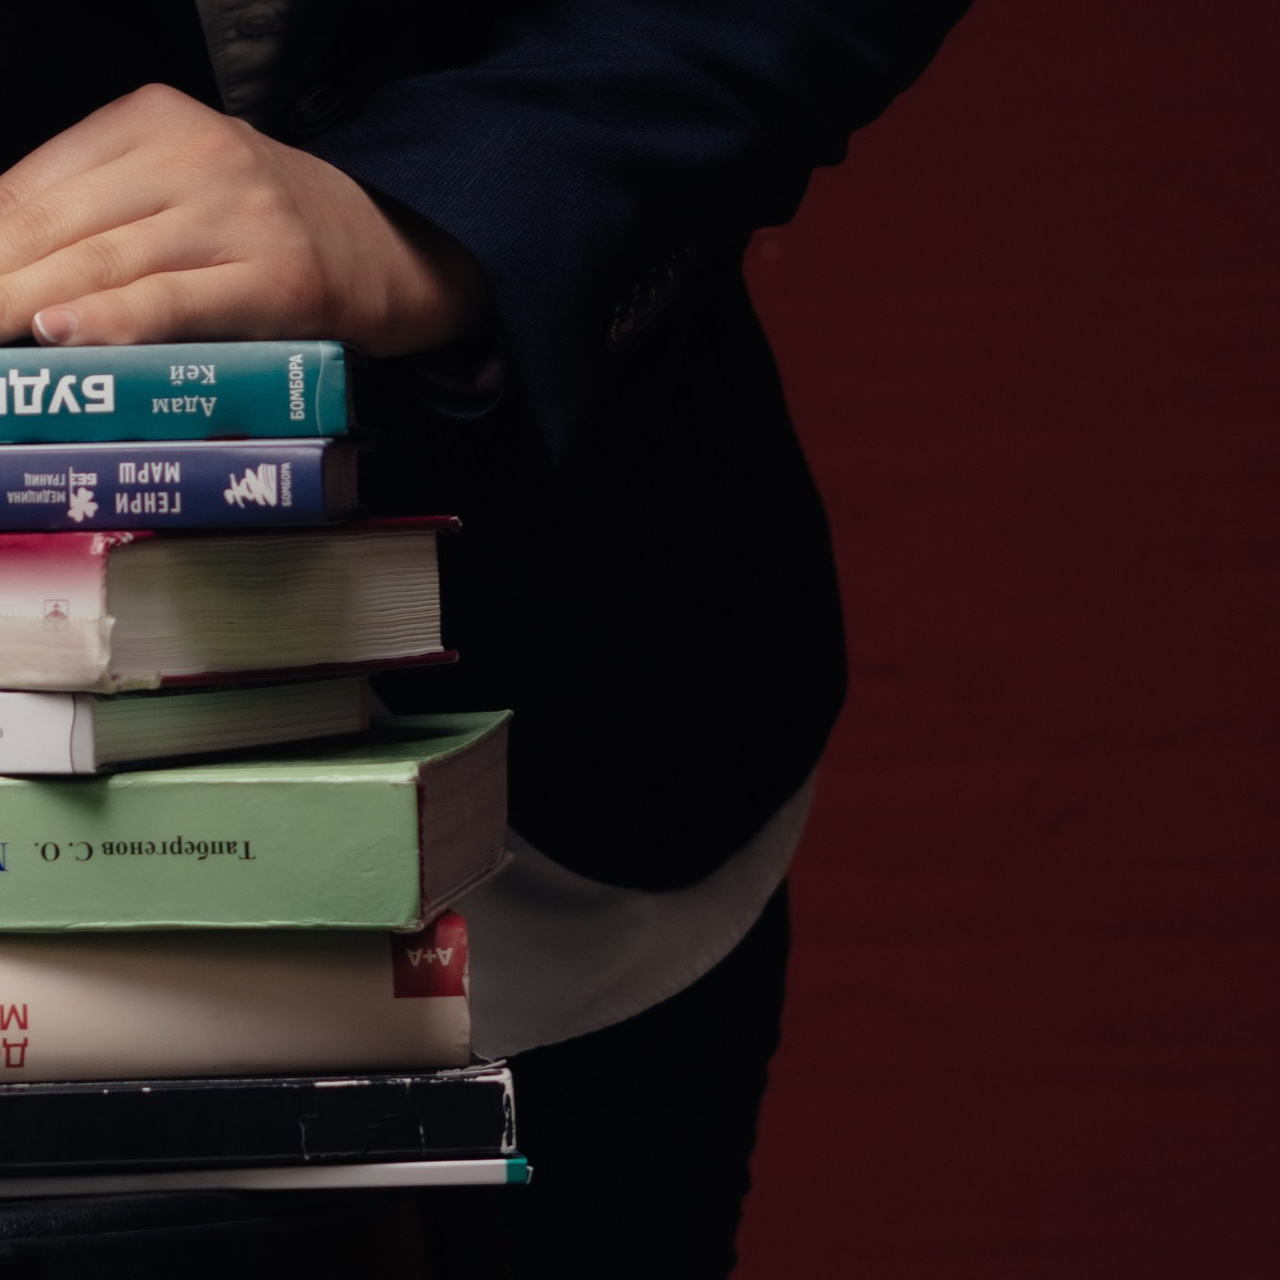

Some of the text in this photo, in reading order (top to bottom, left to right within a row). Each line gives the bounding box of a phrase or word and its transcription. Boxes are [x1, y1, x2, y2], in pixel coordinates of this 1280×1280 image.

[170, 364, 216, 385] Кей
[289, 353, 305, 420] БОМБОРА
[152, 396, 217, 416] Адам
[24, 472, 97, 487] БЕЗ ГРАНИЦ
[119, 462, 181, 484] МАРШ
[280, 462, 293, 507] БОМБОРА
[6, 491, 66, 504] МЕДИЦИНА
[116, 491, 181, 514] ГЕНРИ
[34, 836, 256, 861] Тапбергенов С. О.
